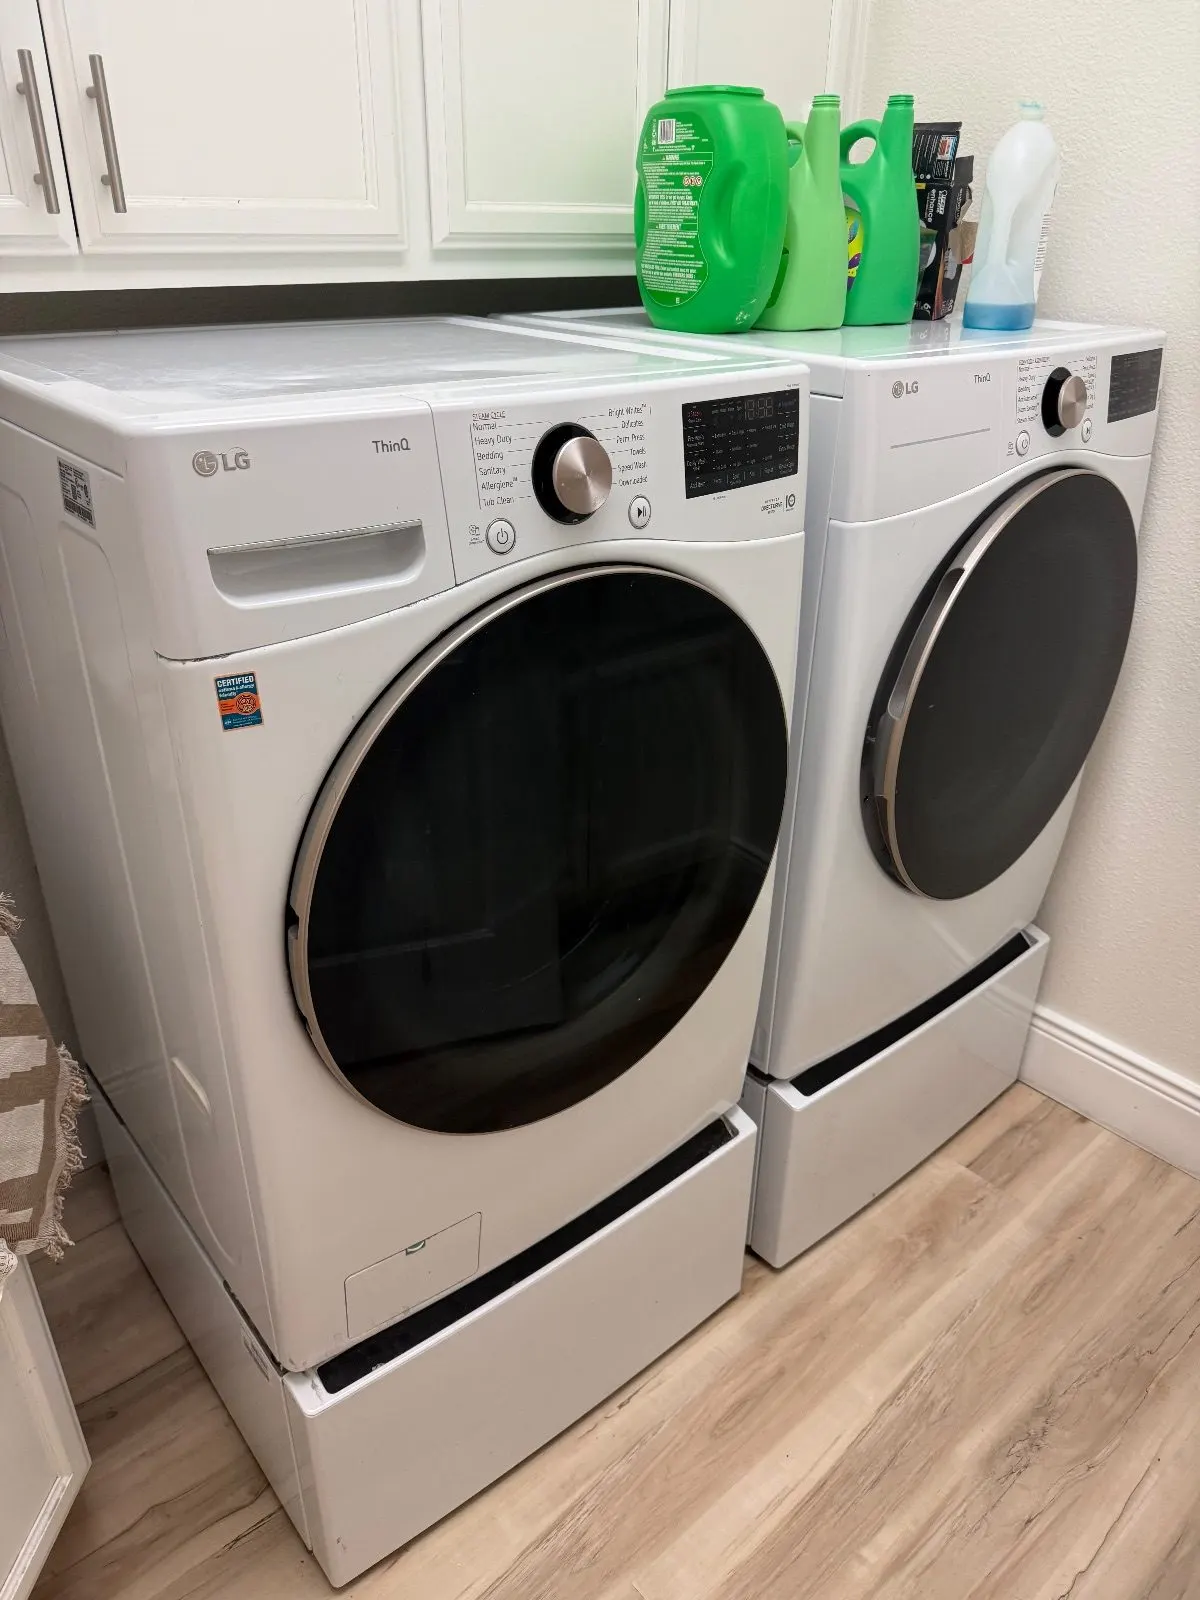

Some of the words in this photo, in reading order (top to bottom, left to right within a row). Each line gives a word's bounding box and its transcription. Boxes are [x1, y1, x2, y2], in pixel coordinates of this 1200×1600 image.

[927, 189, 937, 223] enhance
[973, 373, 991, 384] ThinQ
[905, 381, 919, 395] LG
[472, 422, 497, 431] Normal
[372, 438, 411, 454] ThinQ
[474, 436, 495, 447] Heavy
[496, 434, 512, 445] Duty
[222, 451, 251, 472] LG
[476, 451, 504, 461] Bedding
[478, 466, 506, 476] Sanitary
[216, 675, 255, 688] CERTIFIED
